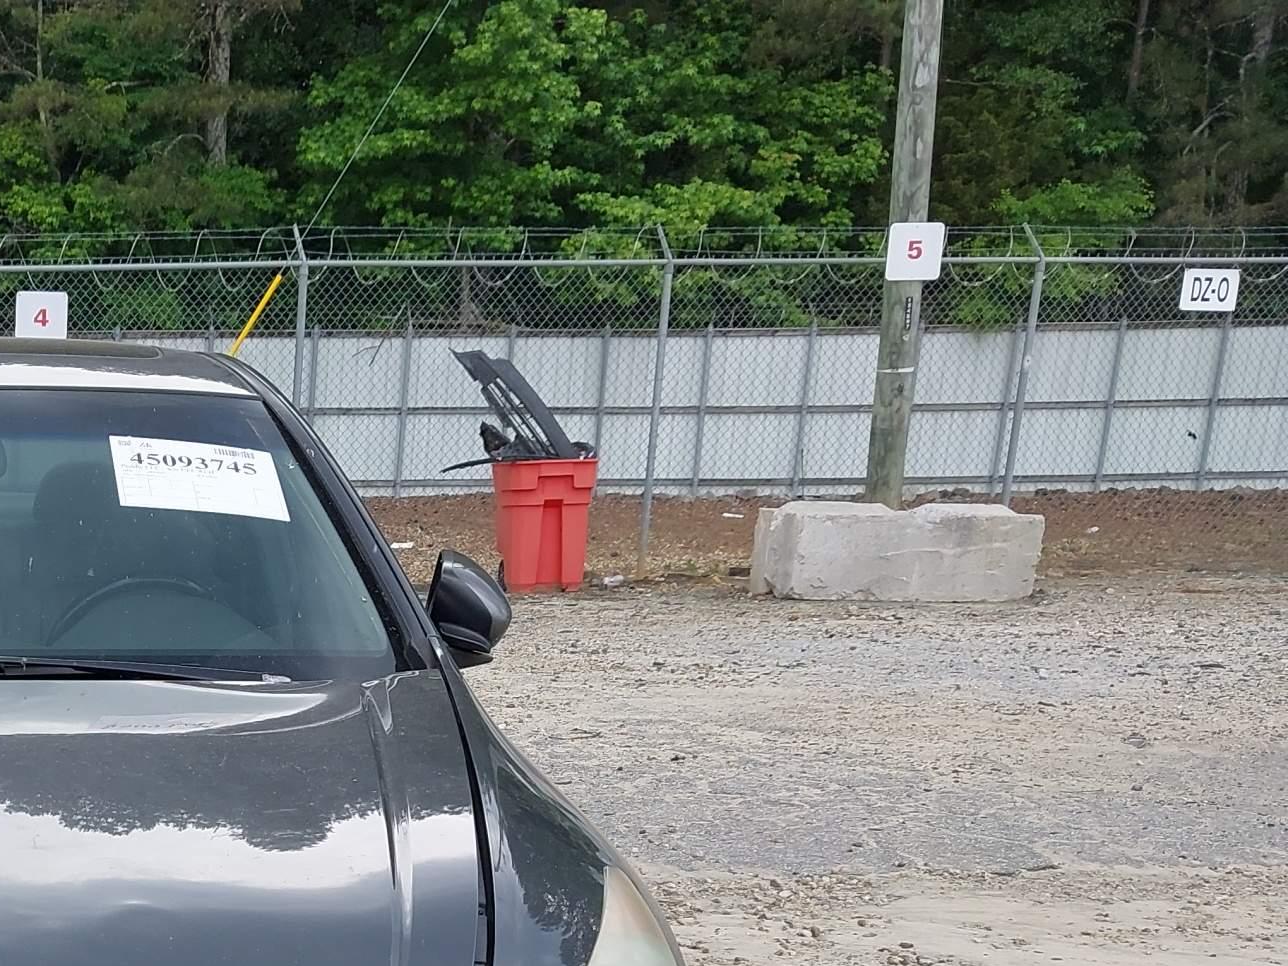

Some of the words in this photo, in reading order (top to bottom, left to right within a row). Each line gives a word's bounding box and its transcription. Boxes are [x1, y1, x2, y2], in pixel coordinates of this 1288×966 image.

[907, 240, 923, 260] 5
[33, 308, 49, 327] 4
[129, 452, 257, 476] 45093745
